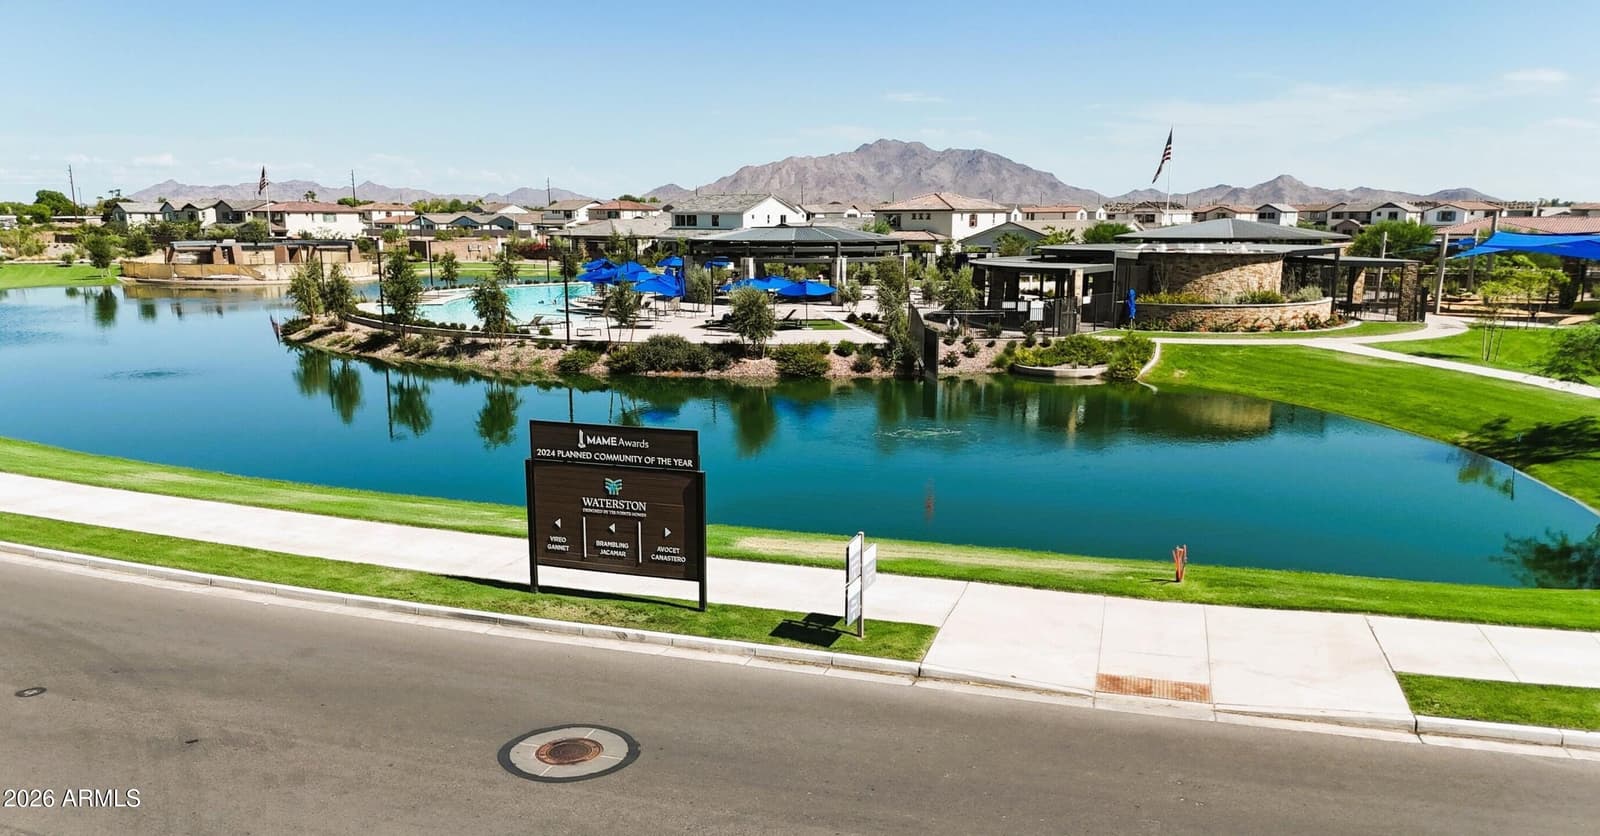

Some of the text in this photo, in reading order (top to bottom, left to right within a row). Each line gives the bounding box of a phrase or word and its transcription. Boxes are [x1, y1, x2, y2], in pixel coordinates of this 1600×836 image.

[586, 435, 650, 449] MAME Awards
[536, 448, 693, 467] 2024 PLANNED COMMUNITY OF THE YEAR
[582, 497, 647, 511] WATERSTON
[595, 540, 629, 549] BRAMBLING
[600, 549, 627, 557] JACAMAR
[657, 546, 680, 554] AVOCET
[650, 554, 686, 563] CANASTERO
